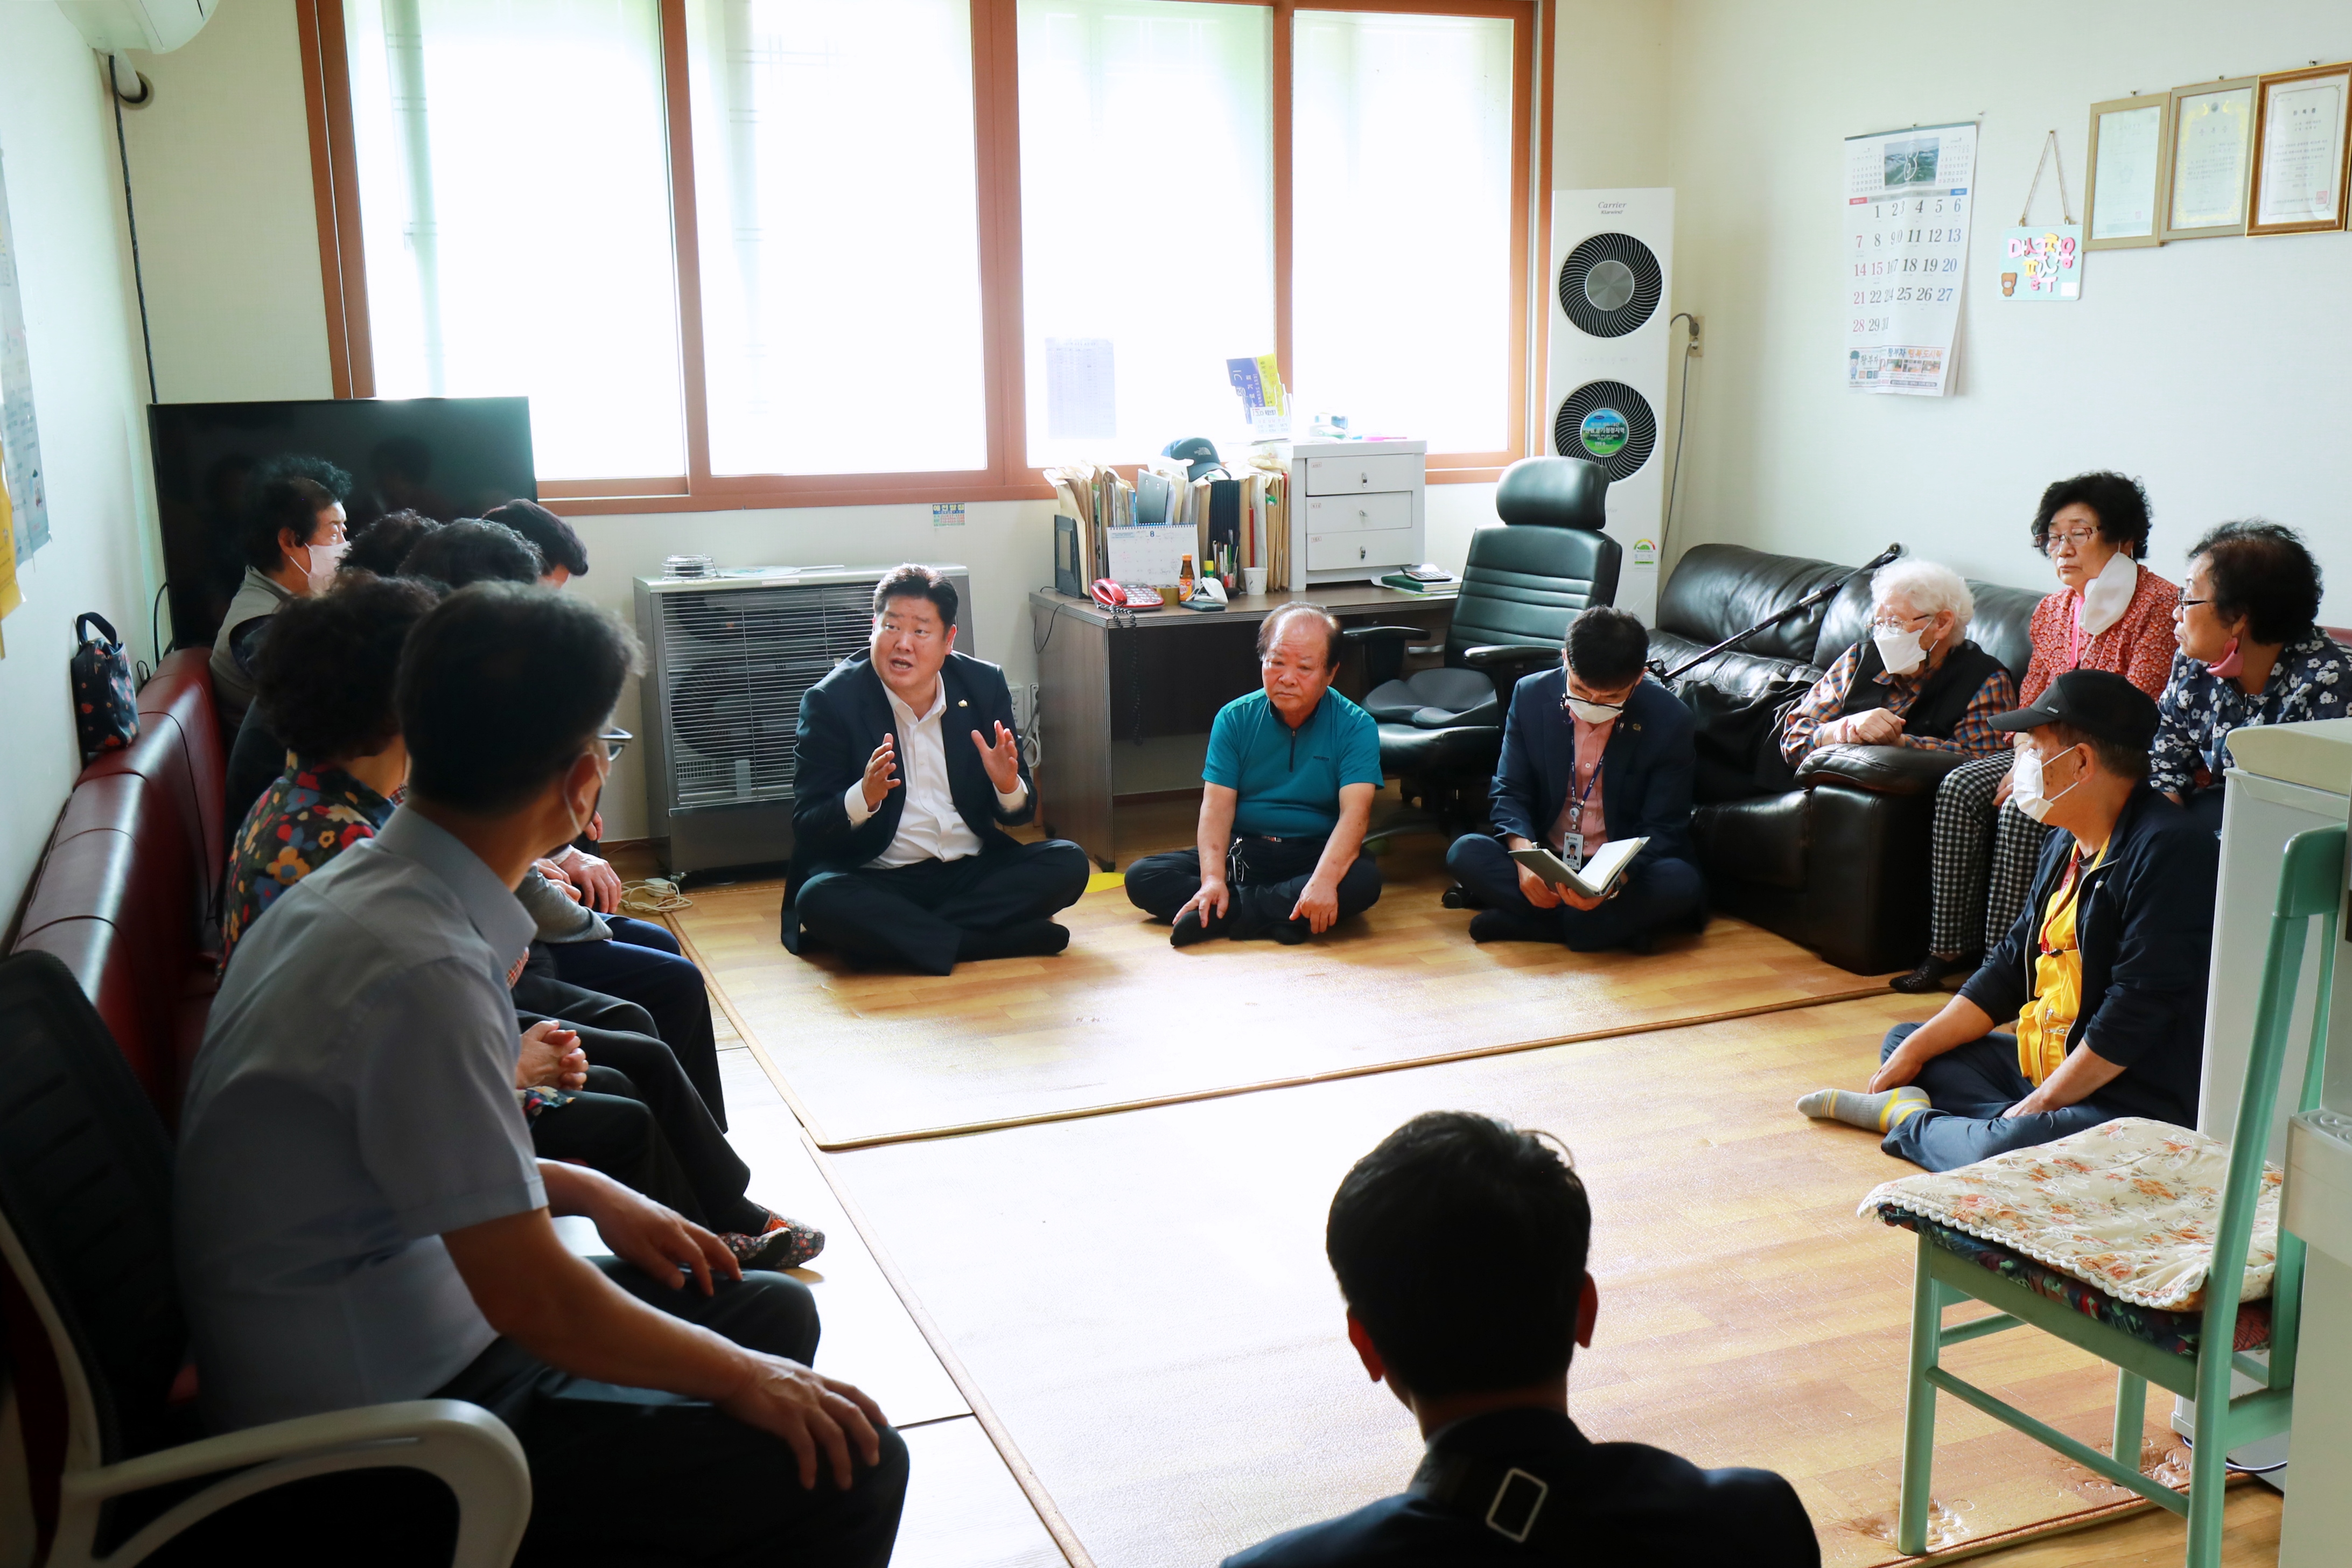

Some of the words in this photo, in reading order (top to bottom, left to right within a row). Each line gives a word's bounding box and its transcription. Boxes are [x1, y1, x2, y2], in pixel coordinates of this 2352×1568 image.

[1875, 205, 1880, 218] 1
[1892, 202, 1898, 216] 2
[1900, 200, 1905, 214] 3
[1915, 199, 1923, 213] 4
[1935, 199, 1943, 213] 5
[1954, 198, 1961, 212] 6
[1856, 235, 1863, 248] 7
[1874, 233, 1881, 247] 8
[1891, 232, 1896, 245] 9
[1908, 229, 1921, 242] 11
[1928, 228, 1942, 242] 12
[1947, 228, 1961, 242] 13
[2008, 237, 2048, 262] 마스크
[2045, 233, 2075, 269] 착용
[1854, 263, 1866, 276] 14
[1872, 262, 1883, 275] 15
[1902, 258, 1917, 272] 18
[1923, 258, 1938, 272] 19
[1942, 258, 1957, 272] 20
[2023, 260, 2059, 292] 필수
[1854, 291, 1865, 304] 21
[1870, 290, 1882, 303] 22
[1896, 287, 1912, 301] 25
[1916, 287, 1933, 302] 26
[1937, 288, 1954, 302] 27
[1853, 319, 1865, 332] 28
[1868, 318, 1880, 331] 29
